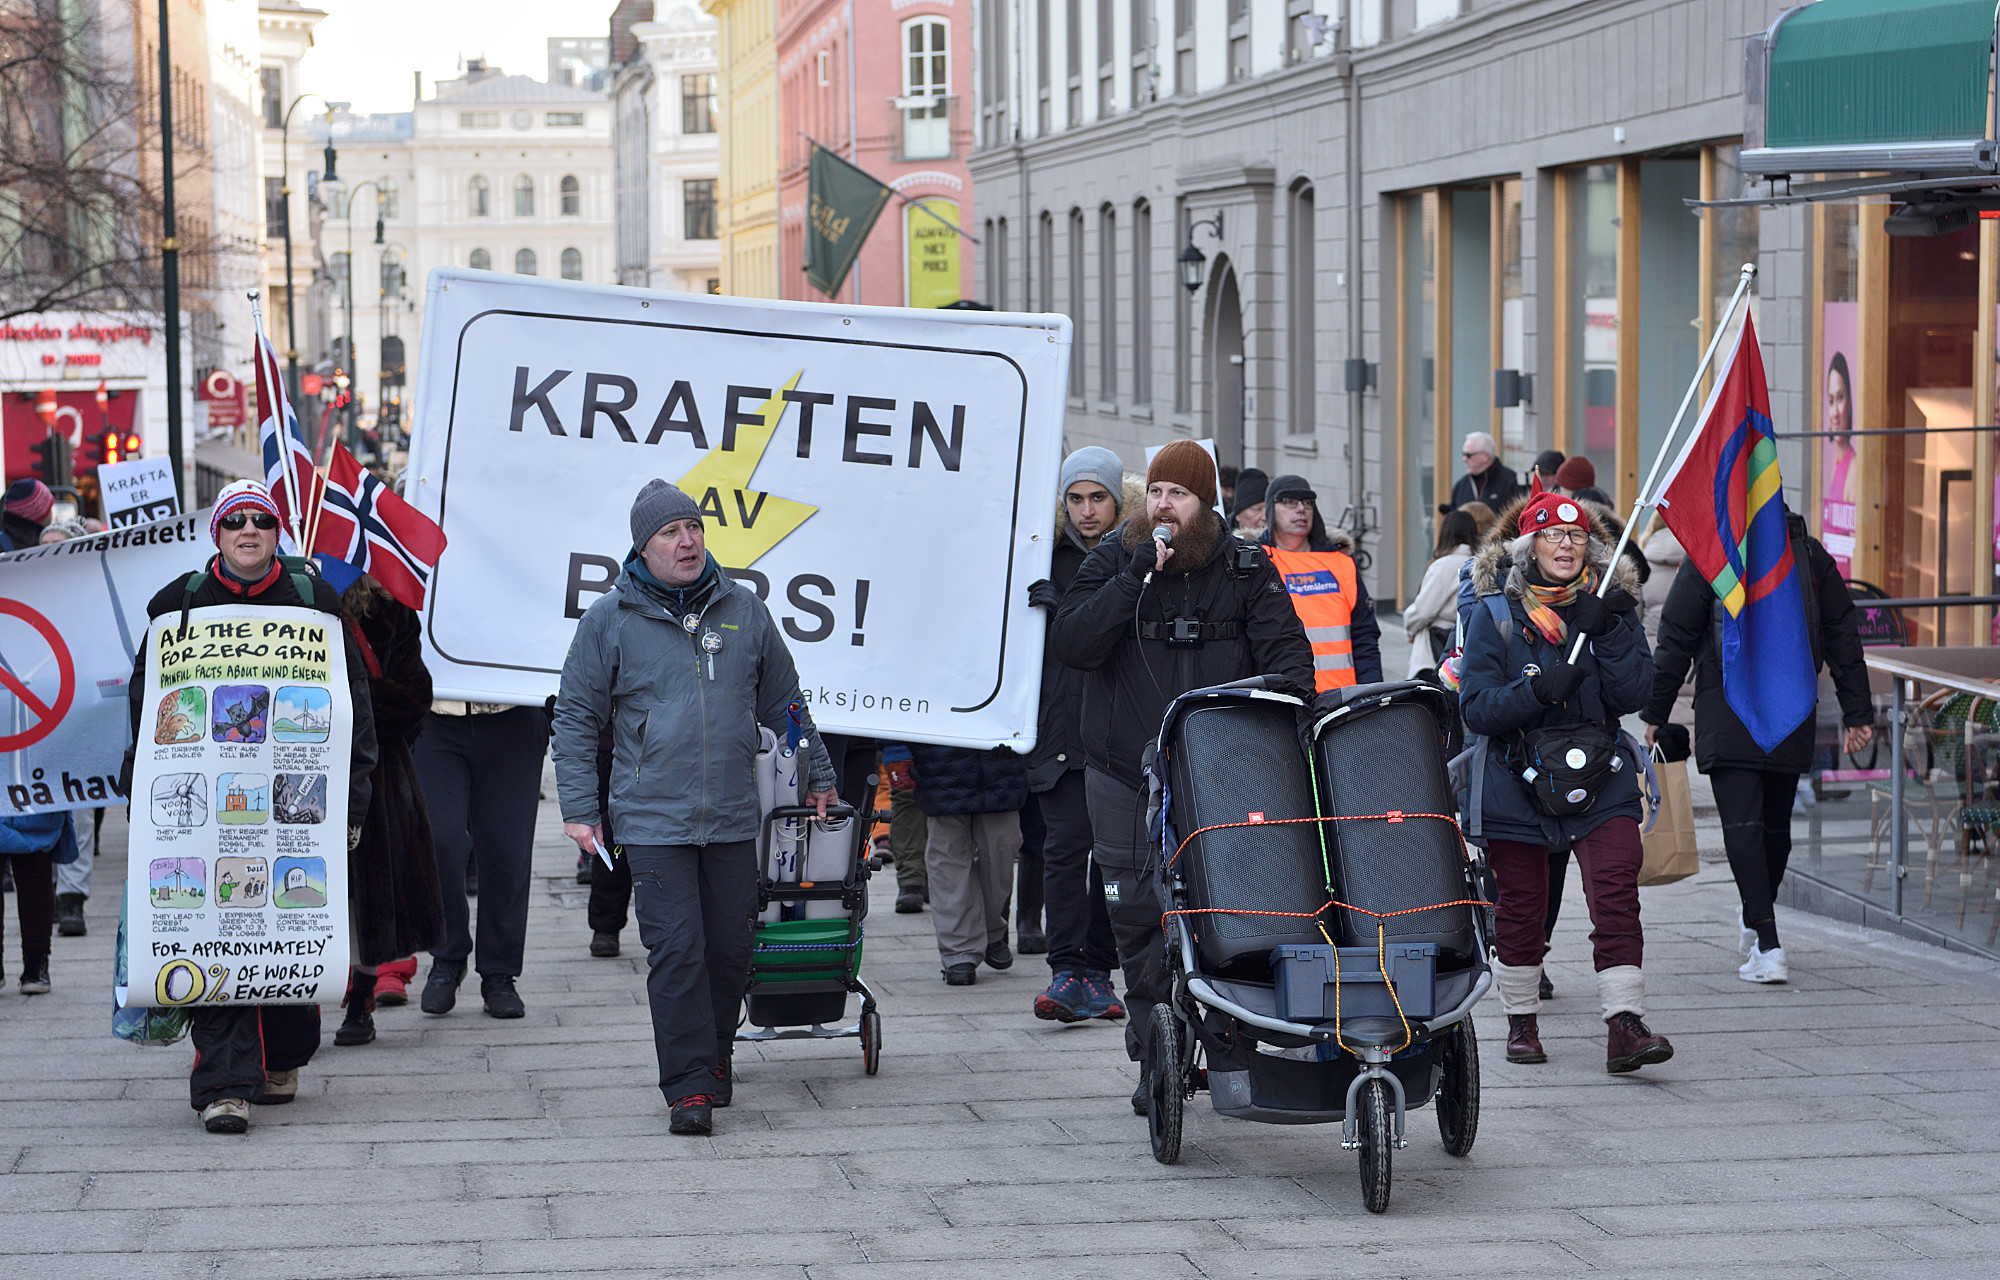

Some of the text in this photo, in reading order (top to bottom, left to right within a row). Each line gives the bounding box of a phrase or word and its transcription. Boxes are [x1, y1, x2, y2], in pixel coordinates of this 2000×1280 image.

[69, 323, 152, 344] shopping
[509, 366, 965, 471] KRAFTEN
[108, 469, 168, 493] KRAFTA
[132, 489, 150, 504] ER
[698, 487, 768, 529] AV
[68, 518, 197, 555] matfatet!
[564, 552, 871, 647] BS!
[205, 623, 252, 638] THE
[263, 623, 324, 643] PAIN
[161, 643, 326, 668] FOR ZERO GAIN
[161, 665, 326, 688] PAINFUL FACTS ABOUT WIND ENERGY
[802, 686, 930, 714] aksjonen
[7, 767, 54, 812] på
[301, 775, 315, 794] DRILL
[161, 801, 190, 810] VOOM
[290, 874, 302, 883] RIP
[152, 941, 187, 957] FOR
[237, 965, 260, 982] OF
[264, 963, 324, 979] WORLD
[234, 982, 318, 1000] ENERGY
